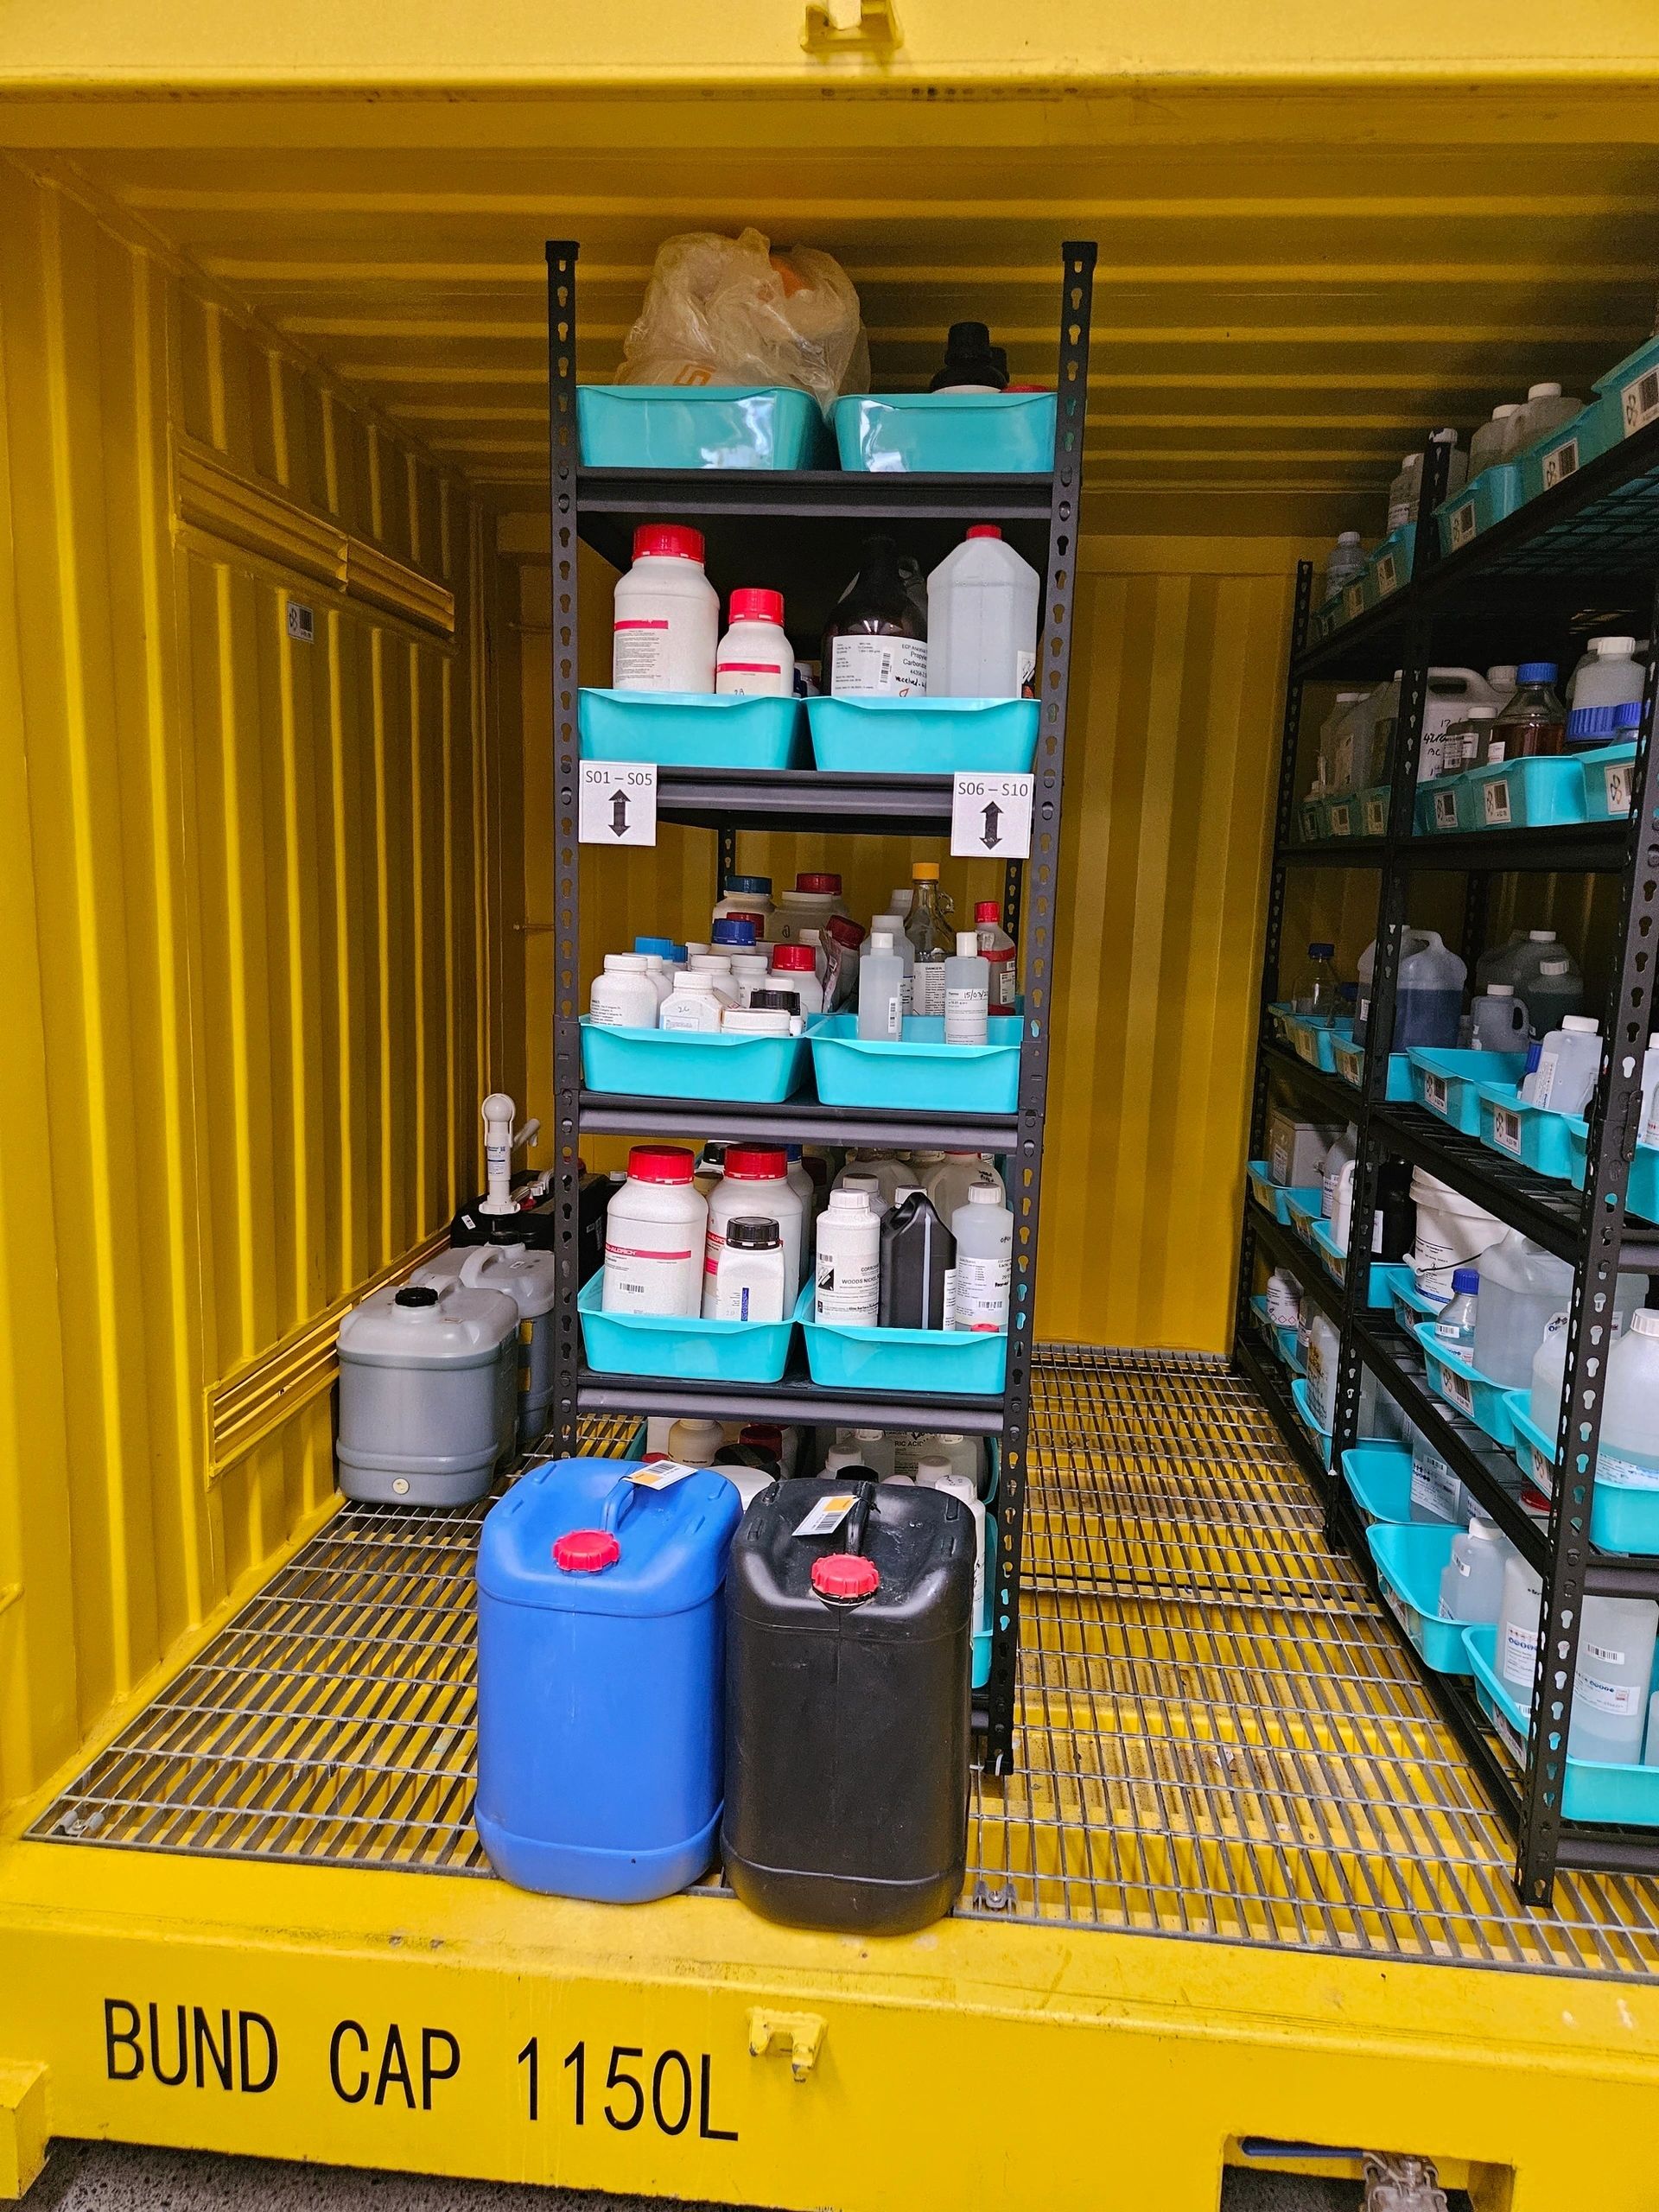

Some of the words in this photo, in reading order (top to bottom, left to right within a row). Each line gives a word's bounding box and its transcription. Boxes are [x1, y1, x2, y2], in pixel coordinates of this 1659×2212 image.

[586, 770, 610, 784] S01
[627, 772, 652, 786] S05
[957, 782, 984, 796] S06
[1001, 783, 1028, 797] S10
[105, 1997, 279, 2093] BUND
[329, 2018, 461, 2111] CAP
[517, 2035, 740, 2141] 1150L
